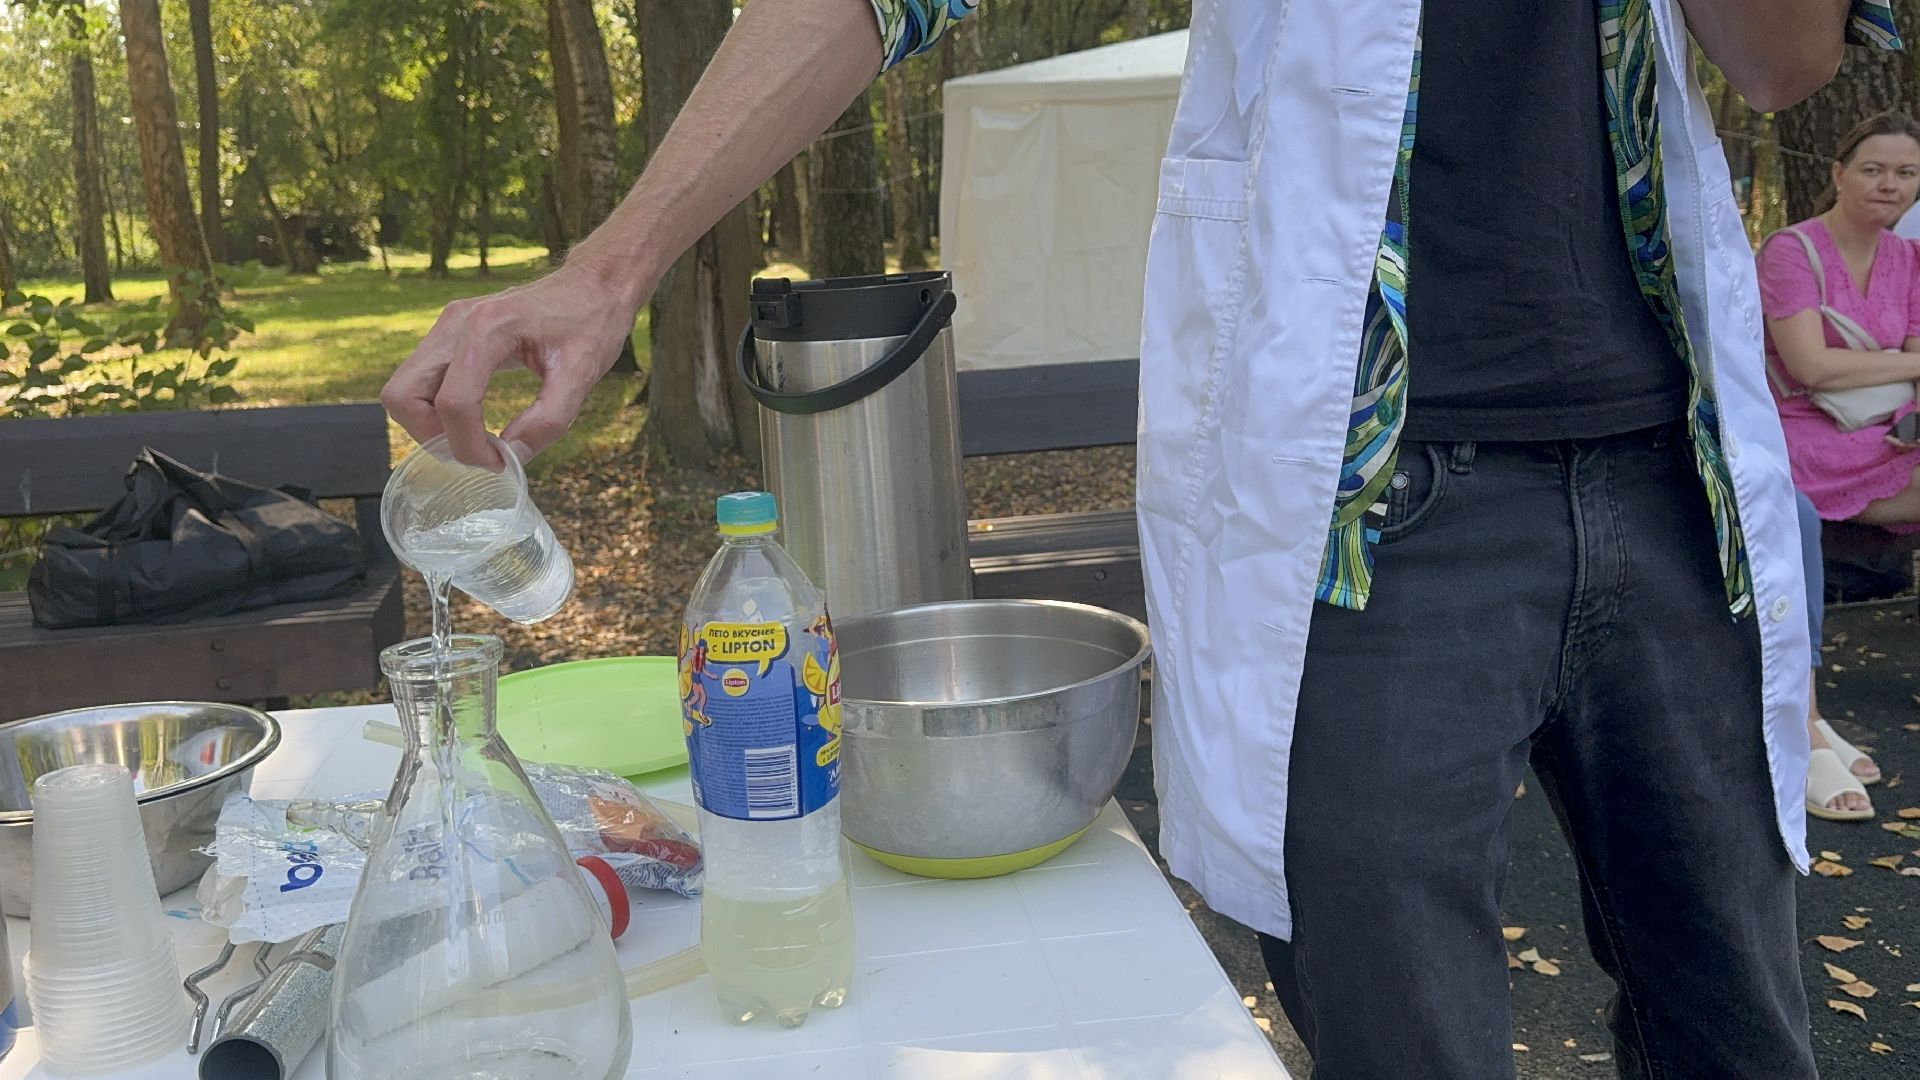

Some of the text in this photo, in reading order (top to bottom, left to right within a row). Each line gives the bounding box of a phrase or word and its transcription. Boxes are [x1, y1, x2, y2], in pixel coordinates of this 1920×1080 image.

[709, 629, 775, 638] ЛЕТО ВКУСНЕЕ
[722, 639, 775, 654] LIPTON
[725, 679, 745, 687] Lipton
